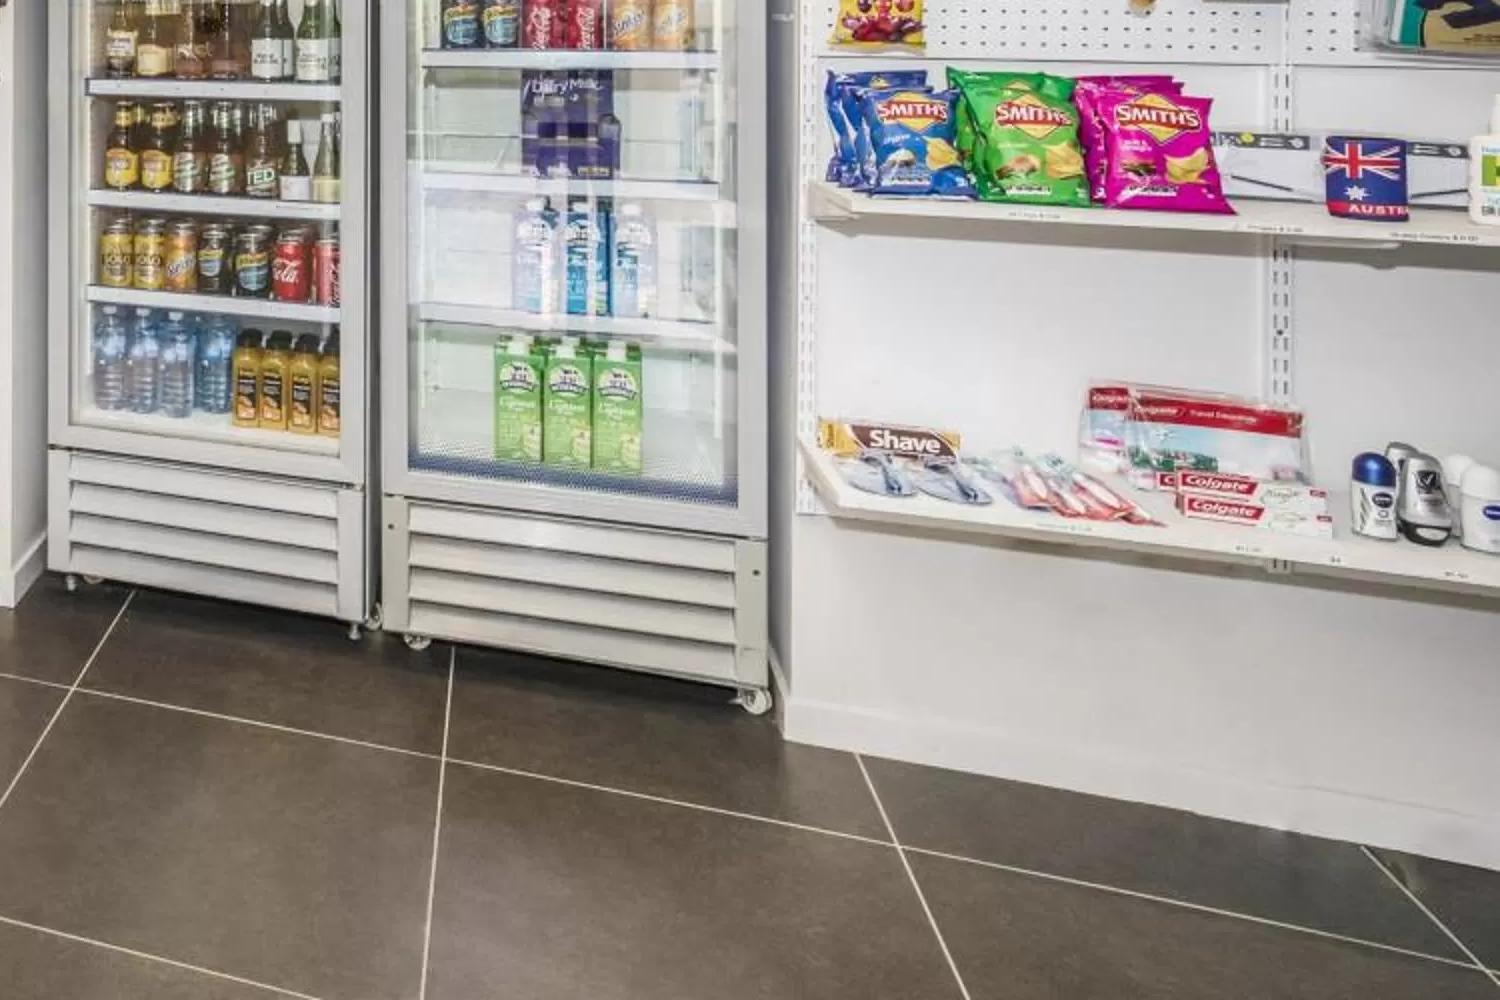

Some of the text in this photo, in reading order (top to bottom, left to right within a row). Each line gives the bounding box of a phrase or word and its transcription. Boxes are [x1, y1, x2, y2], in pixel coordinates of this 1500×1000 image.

[876, 102, 949, 120] SMITH'S
[1116, 105, 1200, 128] SMITH'S
[869, 428, 941, 454] Shave
[1185, 475, 1250, 493] Colgate
[1191, 499, 1259, 517] Colgate
